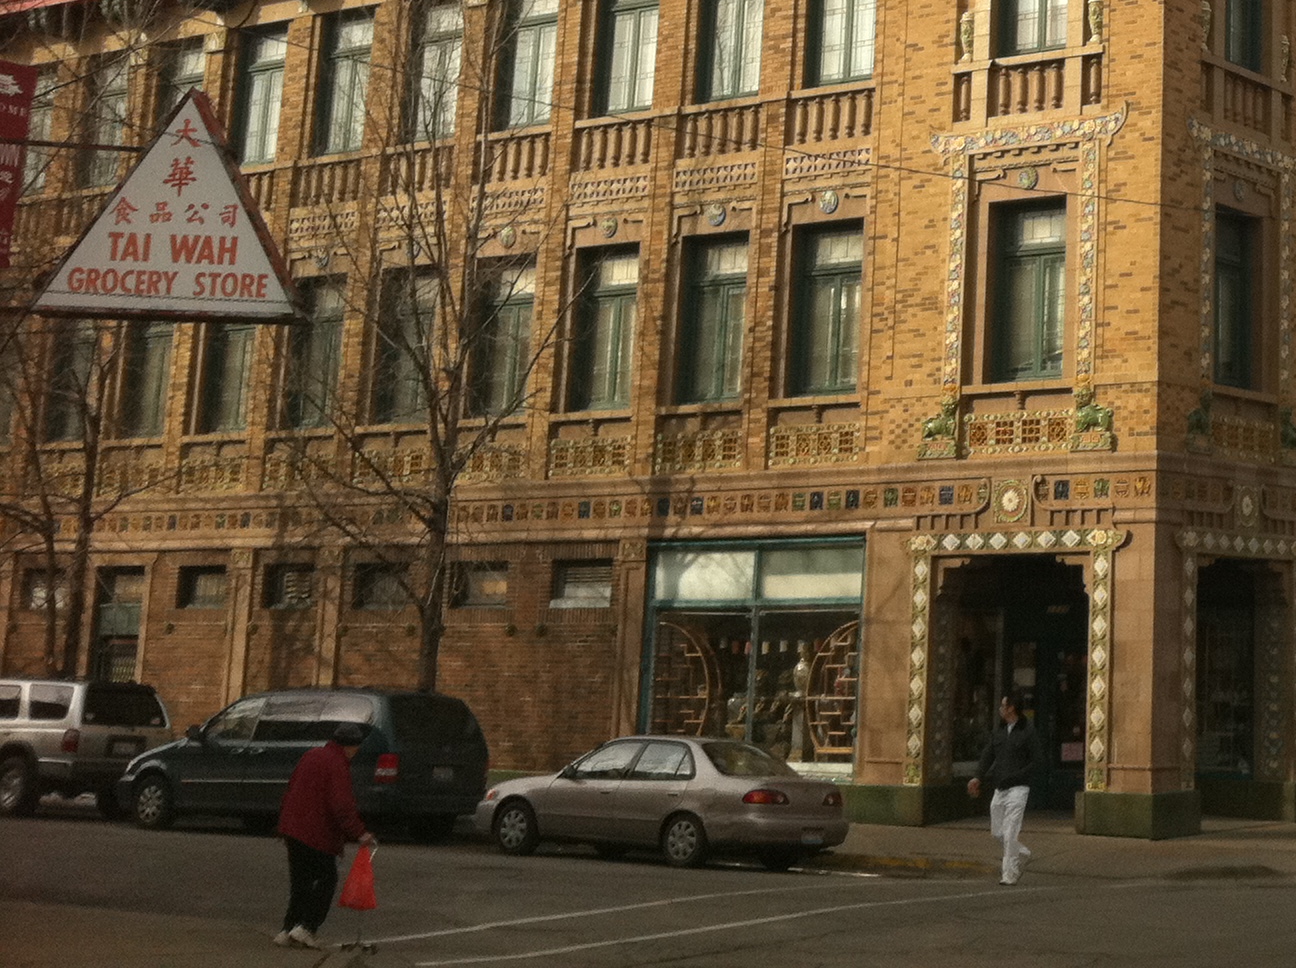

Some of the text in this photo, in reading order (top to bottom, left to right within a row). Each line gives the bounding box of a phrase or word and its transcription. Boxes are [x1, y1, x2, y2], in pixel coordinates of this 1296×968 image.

[110, 197, 239, 227] 食品公司
[109, 232, 238, 265] TAI WAH
[67, 267, 269, 298] GROCERY STORE
